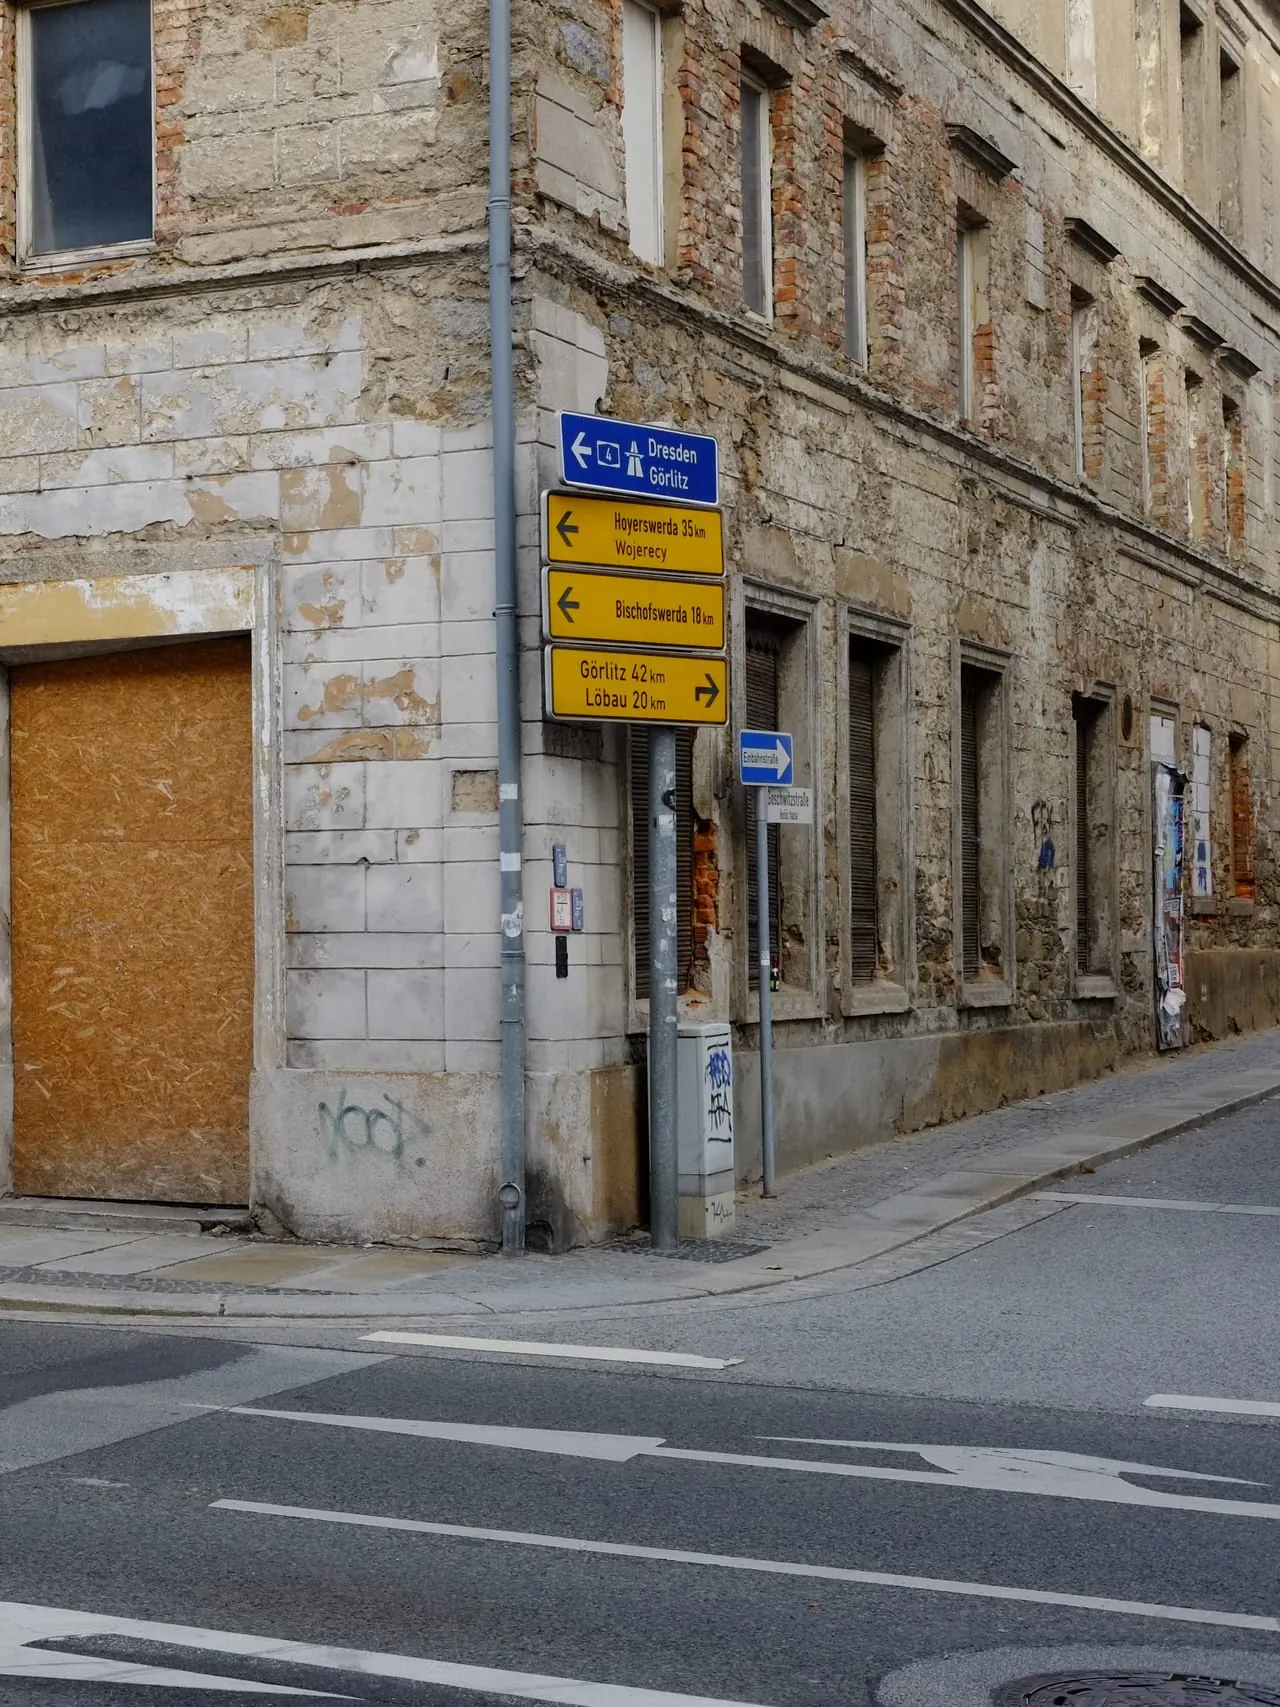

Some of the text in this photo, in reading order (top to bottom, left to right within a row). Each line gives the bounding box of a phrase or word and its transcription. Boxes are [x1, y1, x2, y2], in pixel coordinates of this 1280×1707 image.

[605, 437, 697, 464] 4 Dresden
[649, 466, 689, 490] Görlitz
[614, 511, 706, 539] Hoyerswerda 35 km
[615, 539, 667, 562] Wojerecy
[615, 599, 714, 625] Bischofswerda 18 km
[580, 660, 666, 683] Görlitz 42 km
[585, 687, 666, 710] Löbau 20 km
[743, 751, 779, 765] Einbahnstraße
